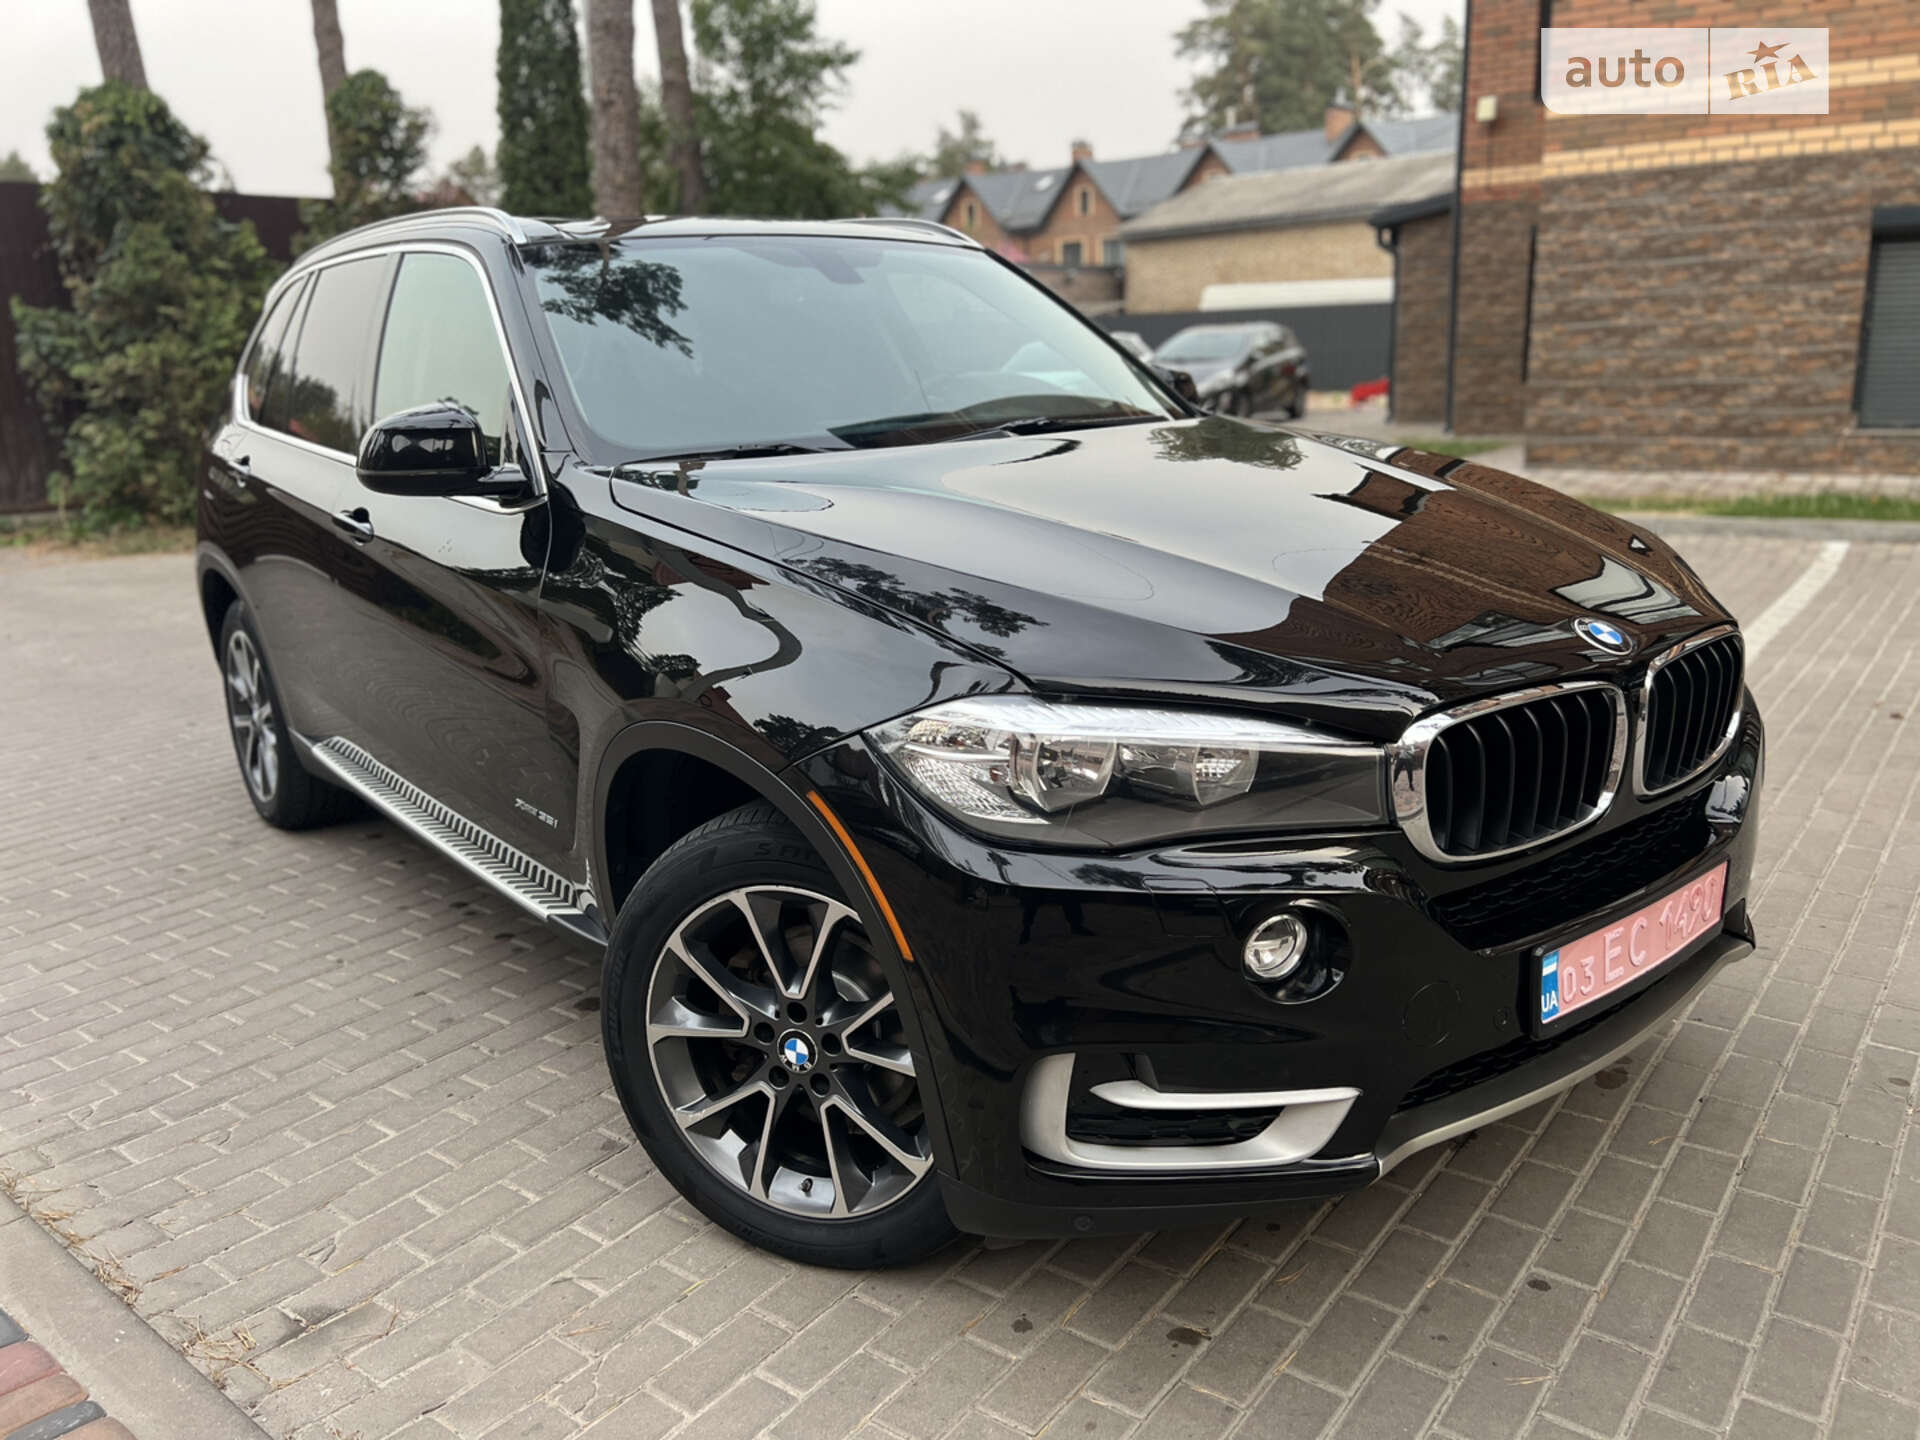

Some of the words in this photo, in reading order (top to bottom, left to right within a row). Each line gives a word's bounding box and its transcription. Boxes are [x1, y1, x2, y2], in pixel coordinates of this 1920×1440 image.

[1562, 955, 1594, 1003] 03
[1603, 916, 1648, 984] EC
[1659, 875, 1715, 950] 1490
[1541, 990, 1558, 1012] UA
